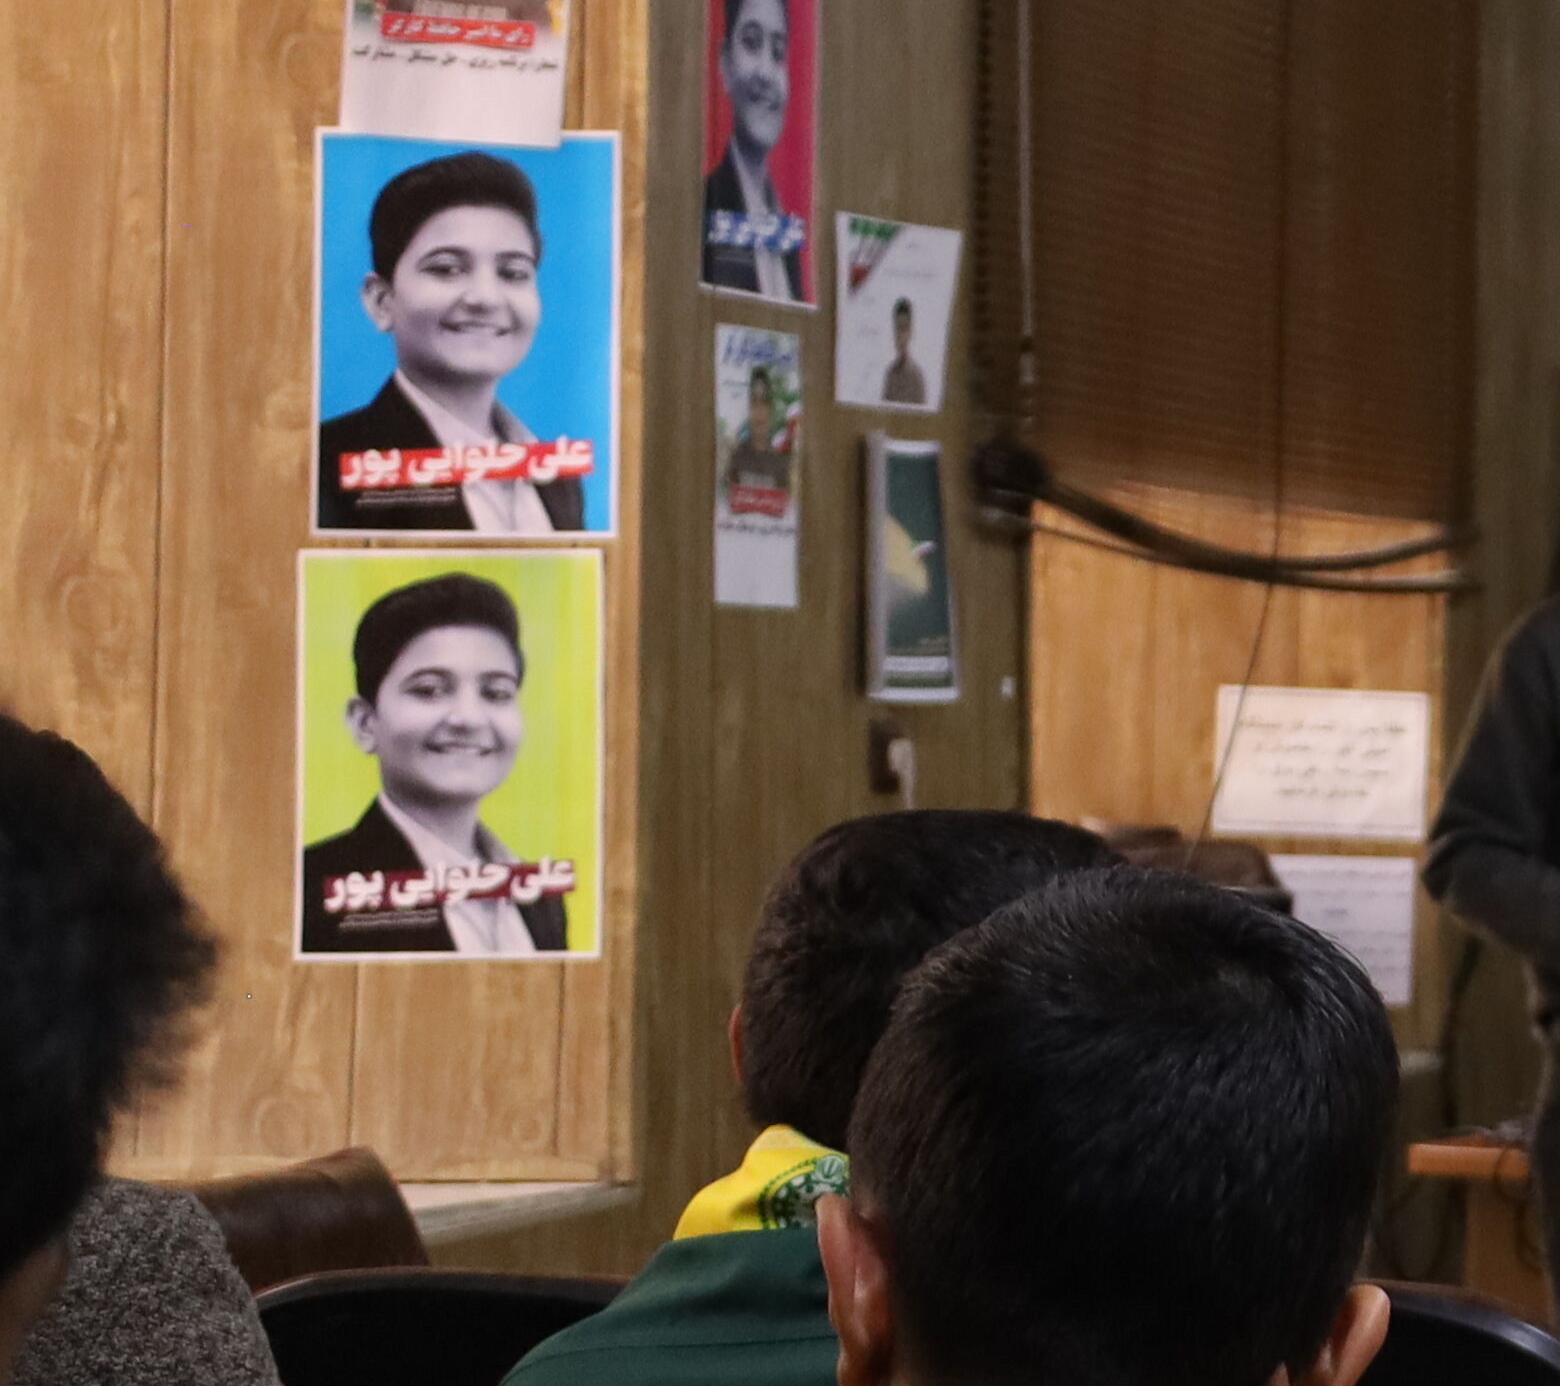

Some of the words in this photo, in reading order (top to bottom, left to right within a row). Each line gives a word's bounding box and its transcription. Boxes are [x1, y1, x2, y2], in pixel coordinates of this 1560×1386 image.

[339, 448, 402, 488] پور
[406, 438, 529, 485] حلوایی
[528, 435, 593, 484] علی
[323, 870, 386, 913] پور
[390, 858, 511, 906] حلوایی
[510, 856, 576, 904] علی
